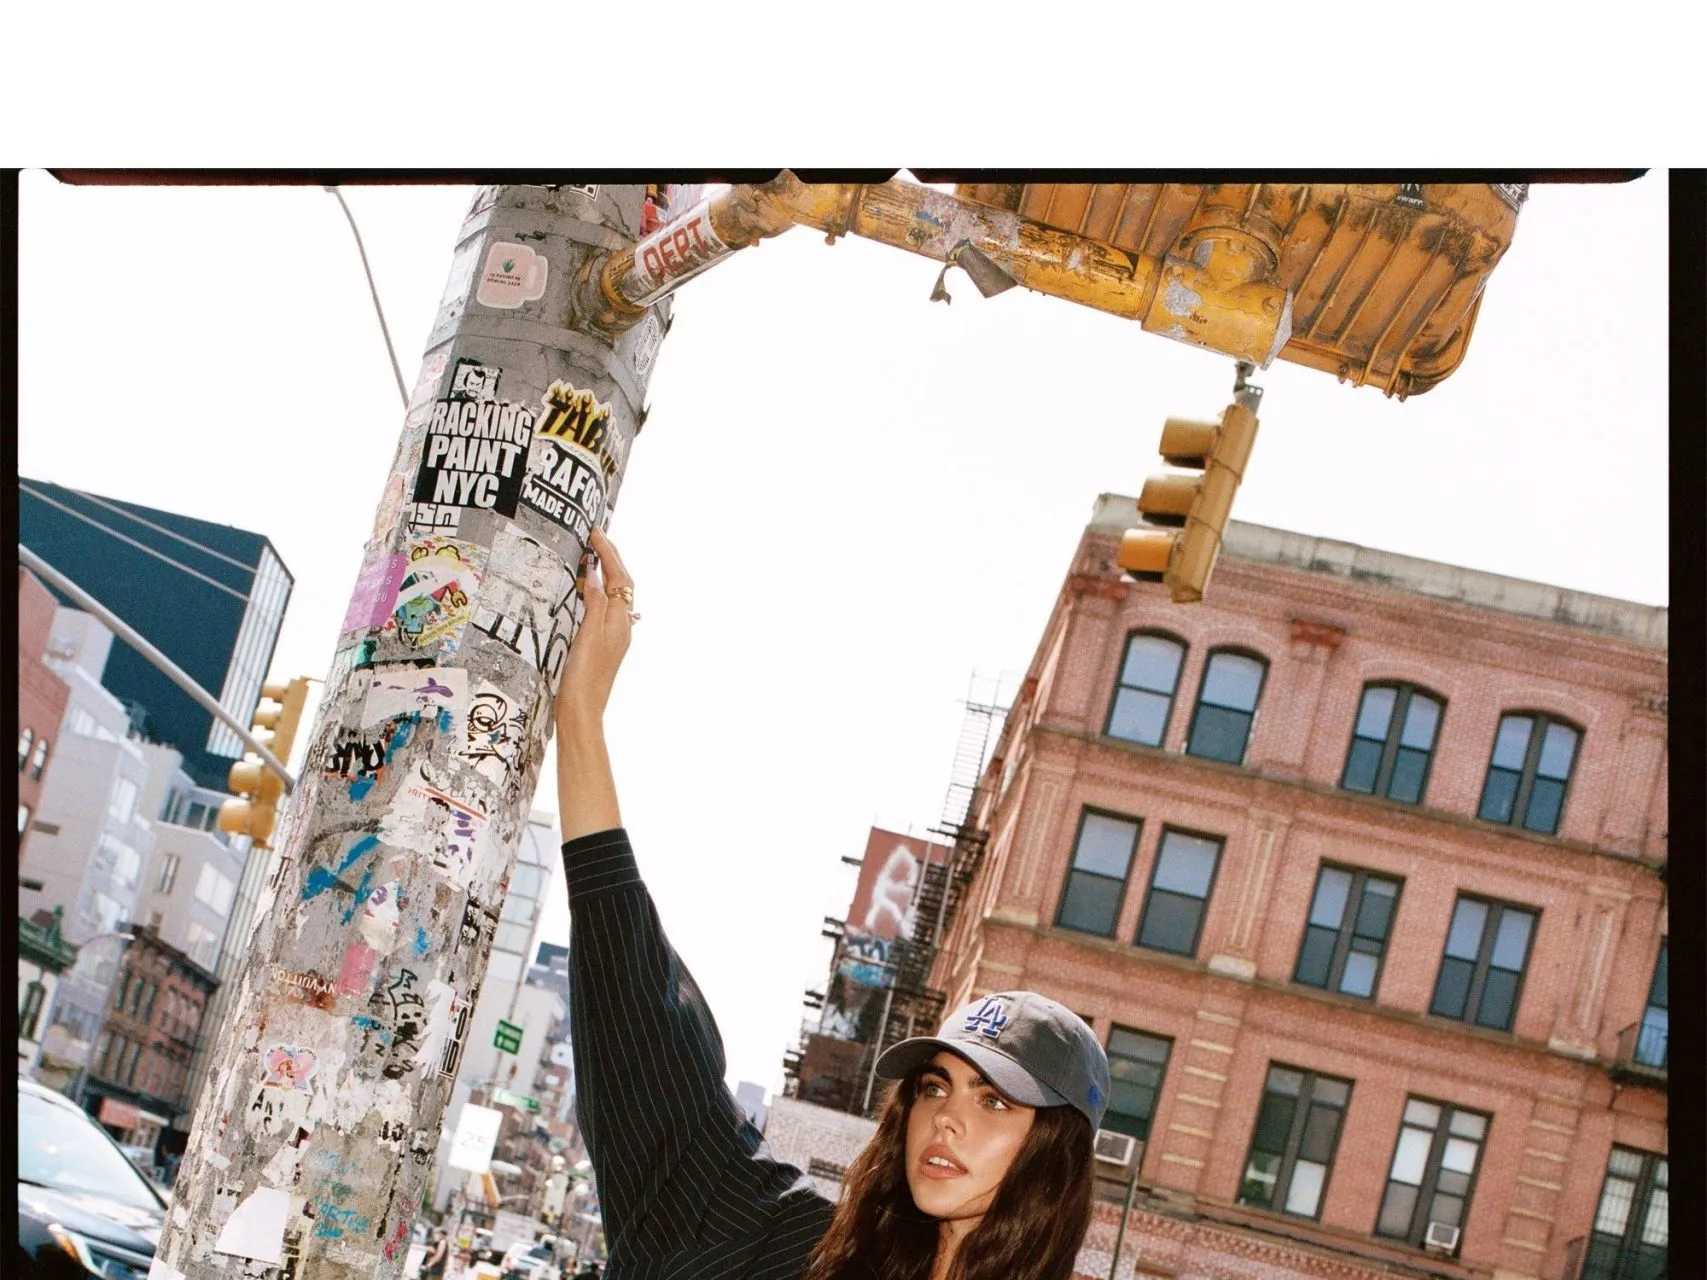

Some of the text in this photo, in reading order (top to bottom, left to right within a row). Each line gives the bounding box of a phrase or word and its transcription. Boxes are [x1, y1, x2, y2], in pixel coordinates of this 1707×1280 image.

[429, 401, 533, 448] RACKING
[427, 435, 522, 478] PAINT
[433, 469, 500, 508] NYC
[523, 482, 563, 519] MADE
[538, 448, 601, 522] RAFOS
[963, 996, 1010, 1039] LA
